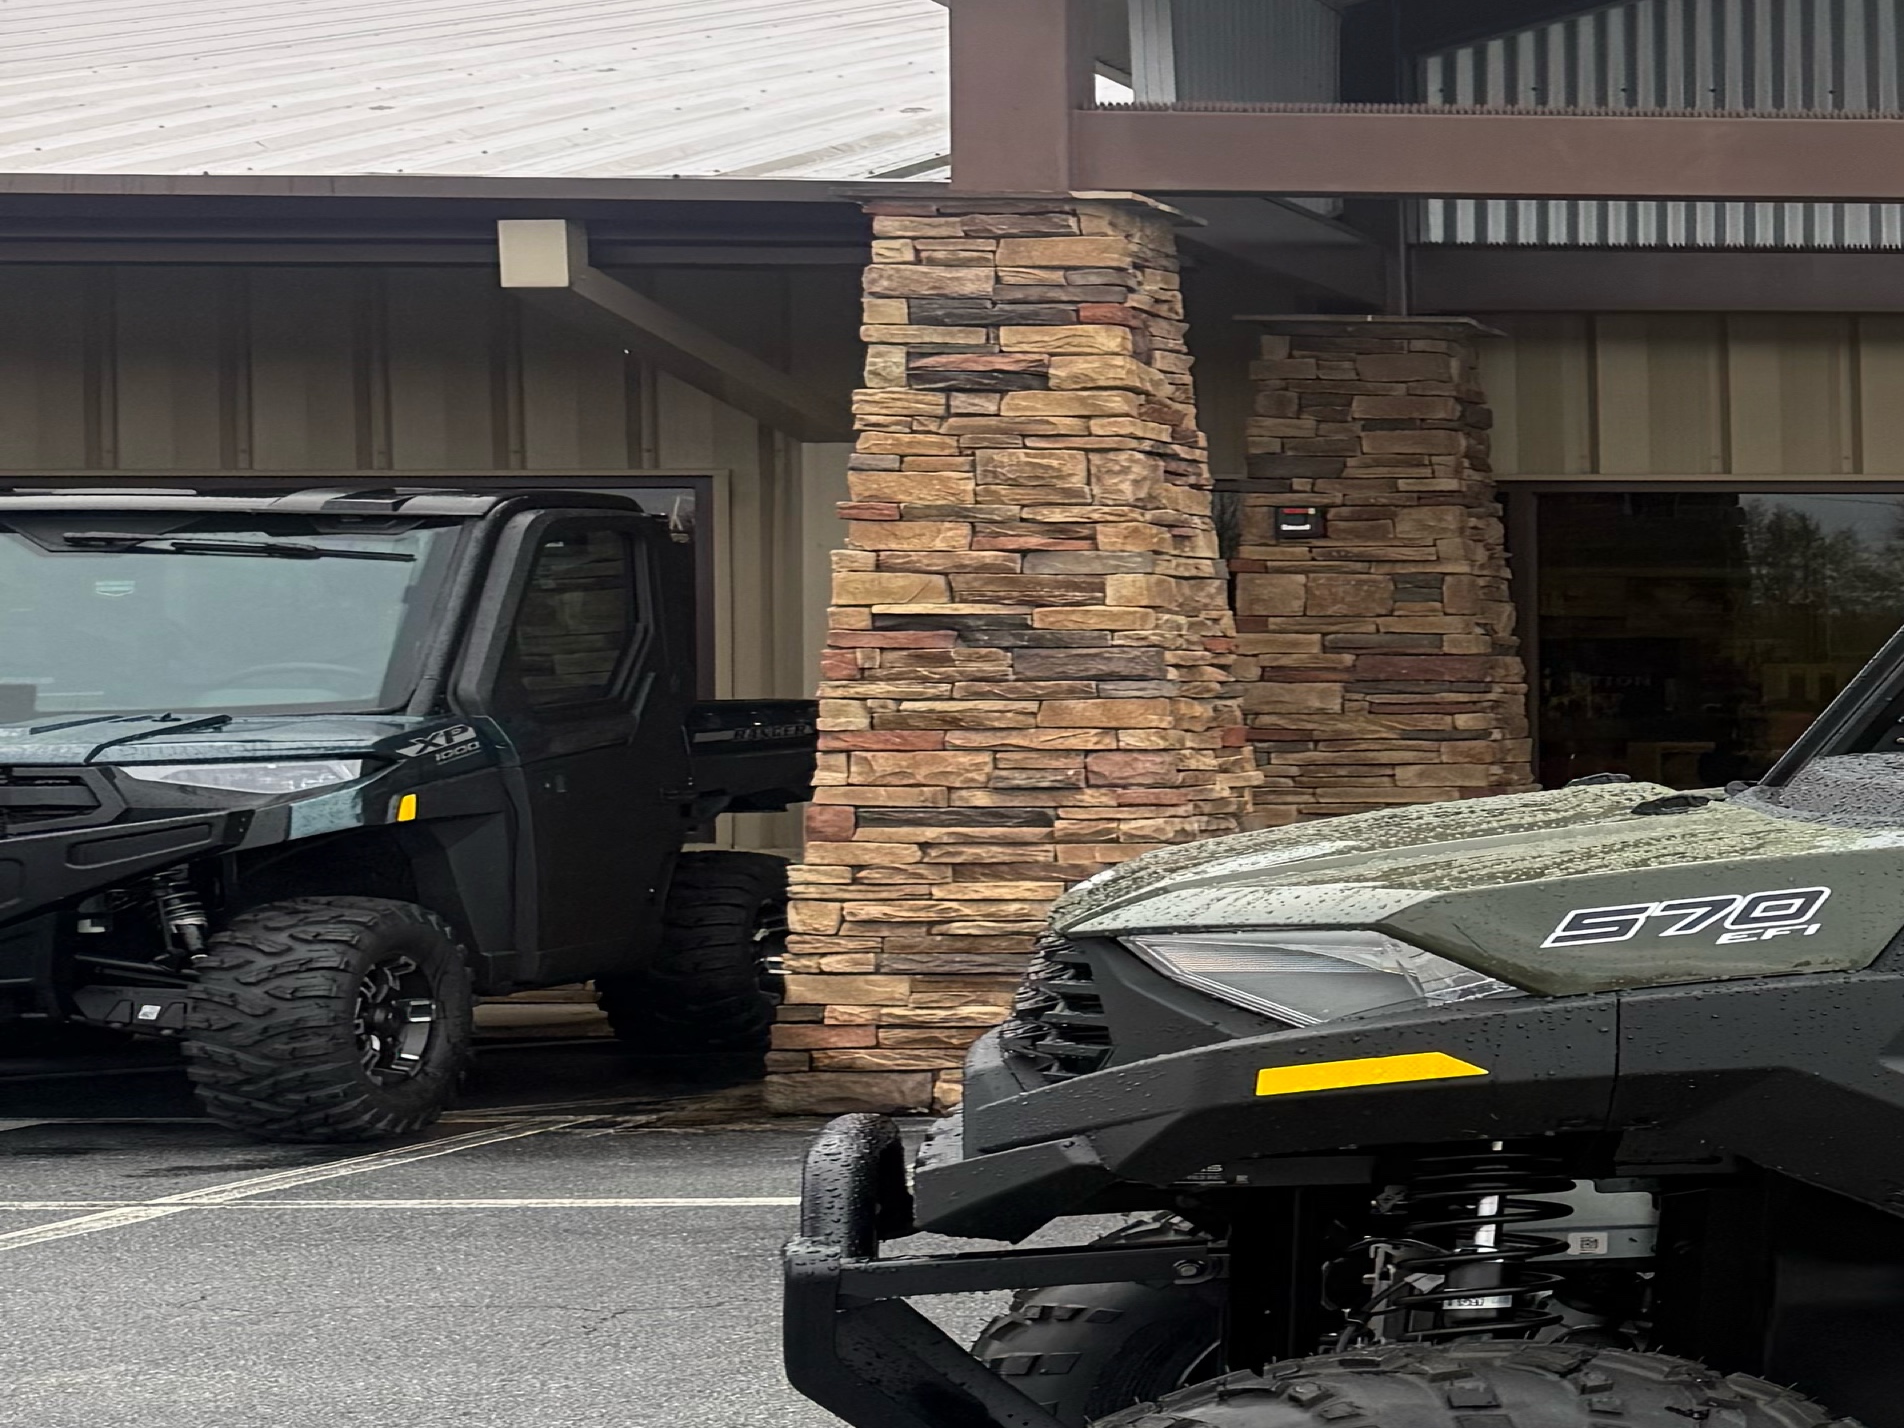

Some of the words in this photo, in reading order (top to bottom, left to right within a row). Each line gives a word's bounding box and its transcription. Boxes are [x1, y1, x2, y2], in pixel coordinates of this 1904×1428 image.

[416, 725, 469, 755] XP
[734, 724, 806, 742] RANGER
[435, 741, 480, 761] 1000
[1540, 887, 1831, 947] 570
[1715, 923, 1821, 945] EFI
